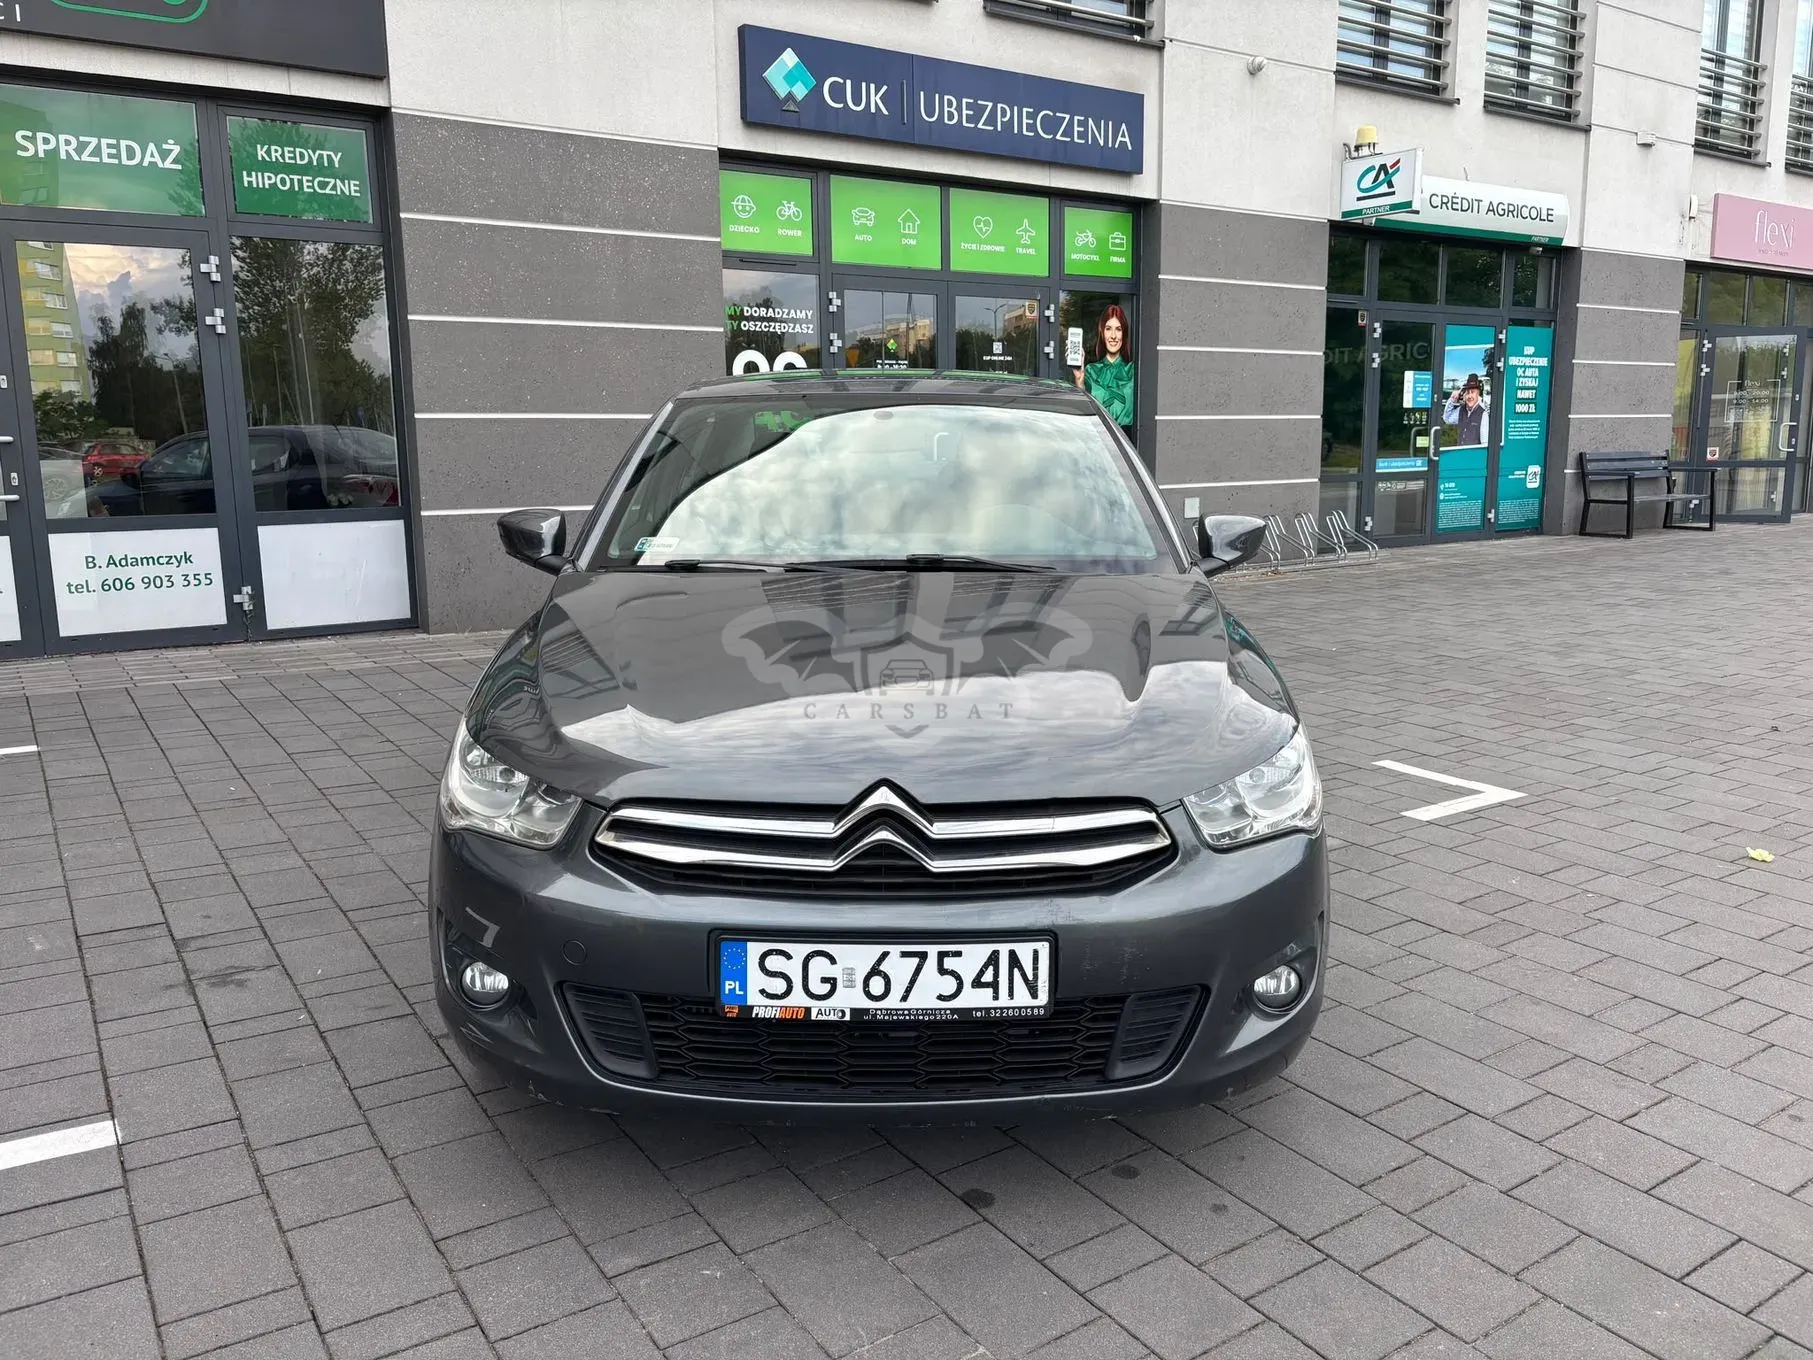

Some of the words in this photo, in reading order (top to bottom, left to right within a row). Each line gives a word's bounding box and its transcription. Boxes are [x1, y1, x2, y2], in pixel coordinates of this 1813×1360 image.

[822, 76, 890, 115] CUK
[919, 91, 1133, 151] UBEZPIECZENIA
[14, 129, 182, 170] SPRZEDAŻ
[256, 143, 343, 168] KREDYTY
[242, 170, 362, 197] HIPOTECZNE
[1361, 205, 1390, 216] PARTNER
[1429, 192, 1482, 217] CRÉDIT
[1486, 201, 1554, 223] AGRICOLE
[729, 224, 760, 234] DZIECKO
[777, 228, 802, 238] ROWER
[1754, 209, 1796, 248] flexi
[854, 233, 873, 242] AUTO
[901, 237, 917, 246] DOM
[1109, 256, 1126, 264] FIRMA
[725, 306, 741, 316] MY
[743, 306, 813, 320] DORADZAMY
[740, 321, 814, 335] OSZCZĘDZASZ
[85, 555, 103, 570] B.
[106, 551, 194, 569] Adamczyk
[66, 579, 97, 595] tel.
[101, 576, 136, 593] 606
[141, 574, 176, 590] 903
[181, 572, 214, 588] 355
[758, 948, 838, 1001] SG
[862, 948, 1040, 1002] 6754N
[725, 980, 744, 995] PL
[752, 1006, 806, 1019] PROFIAUTO
